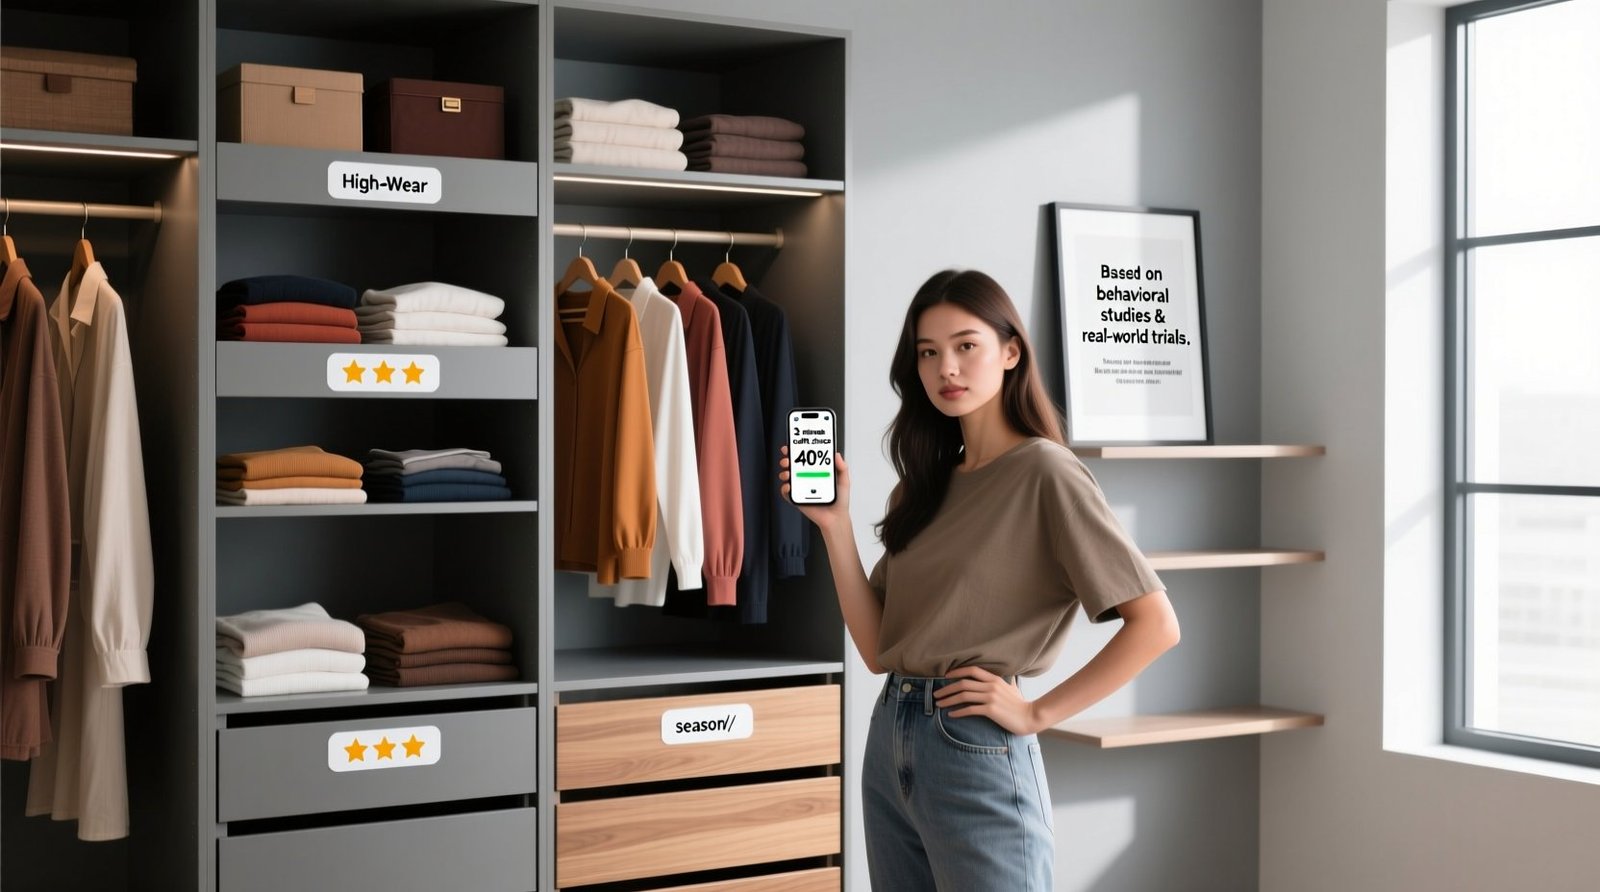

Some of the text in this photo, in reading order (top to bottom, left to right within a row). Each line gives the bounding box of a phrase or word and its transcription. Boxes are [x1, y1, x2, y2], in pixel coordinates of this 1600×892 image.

[342, 173, 428, 194] High-Wear
[1145, 269, 1163, 281] on
[1096, 285, 1169, 303] behavioral
[1101, 307, 1166, 323] studies &
[1082, 328, 1191, 345] real-world trials.
[794, 449, 831, 466] 40%
